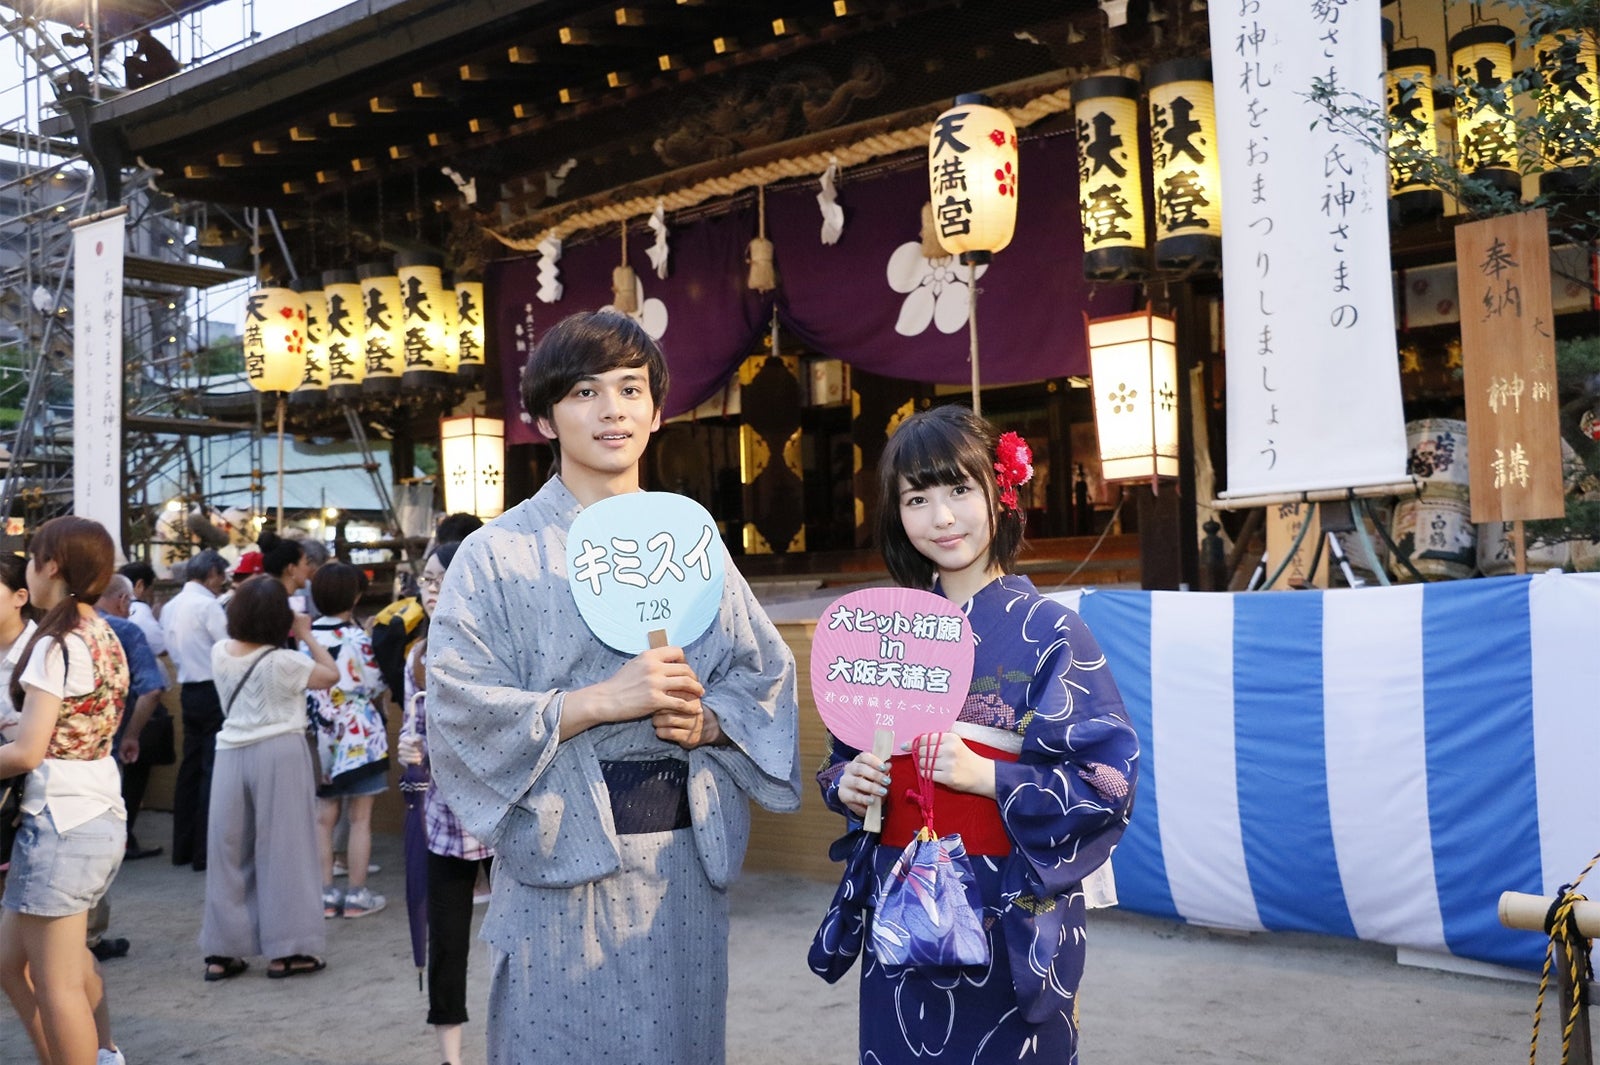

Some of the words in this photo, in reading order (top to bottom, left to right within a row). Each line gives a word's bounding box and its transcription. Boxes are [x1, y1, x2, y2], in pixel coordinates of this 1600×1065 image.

[933, 112, 973, 238] 天満宮
[1479, 237, 1522, 324] 奉納
[246, 294, 269, 380] 天満宮
[574, 524, 713, 597] キミスイ
[636, 598, 672, 623] 7.28
[829, 604, 963, 643] 大ヒット祈願
[879, 635, 905, 661] in
[827, 656, 952, 694] 大阪天満宮
[823, 690, 951, 715] 君の膵臓をたべたい
[875, 712, 895, 727] 7.28
